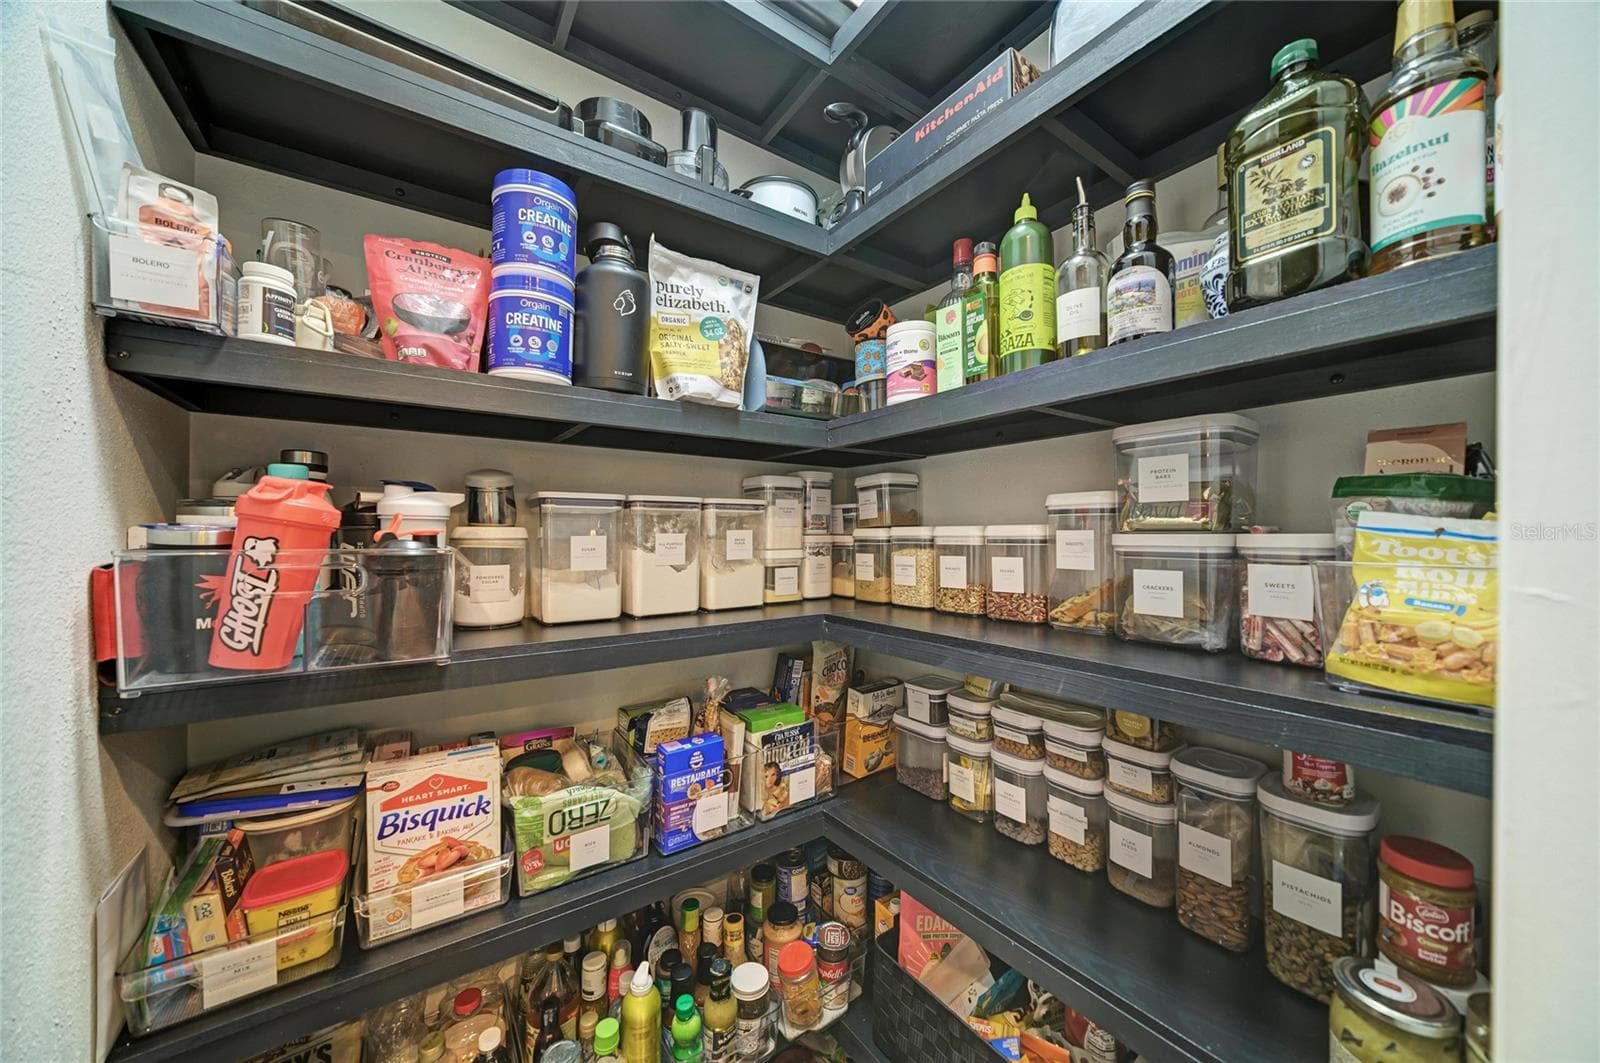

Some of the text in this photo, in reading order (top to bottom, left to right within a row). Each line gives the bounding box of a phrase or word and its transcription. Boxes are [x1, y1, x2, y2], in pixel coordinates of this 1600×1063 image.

[914, 64, 1006, 145] KitchenAid
[1259, 138, 1306, 163] KIRKLAND
[1371, 132, 1450, 177] Hazelnut
[533, 196, 564, 215] Orgain
[154, 217, 200, 236] BOLERO
[517, 207, 572, 239] CREATINE
[131, 255, 171, 270] BOLERO
[655, 280, 705, 302] purely
[519, 297, 551, 312] Orgain
[655, 293, 731, 314] elizabeth.
[505, 311, 563, 334] CREATINE
[937, 330, 961, 343] Bloom
[1150, 467, 1177, 475] PROTEIN
[1142, 583, 1175, 592] CRACKERS
[1264, 581, 1297, 591] SWEETS
[219, 553, 279, 658] GHOST
[822, 658, 849, 678] CHOCO
[670, 766, 722, 789] RESTAURANT
[401, 791, 434, 804] HEART
[376, 794, 492, 841] Bisquick
[548, 798, 612, 837] ZERO
[396, 833, 428, 848] PANCAKE
[1187, 840, 1221, 858] ALMONDS
[1280, 879, 1334, 906] PISTACHIOS
[1389, 898, 1472, 943] Biscoff
